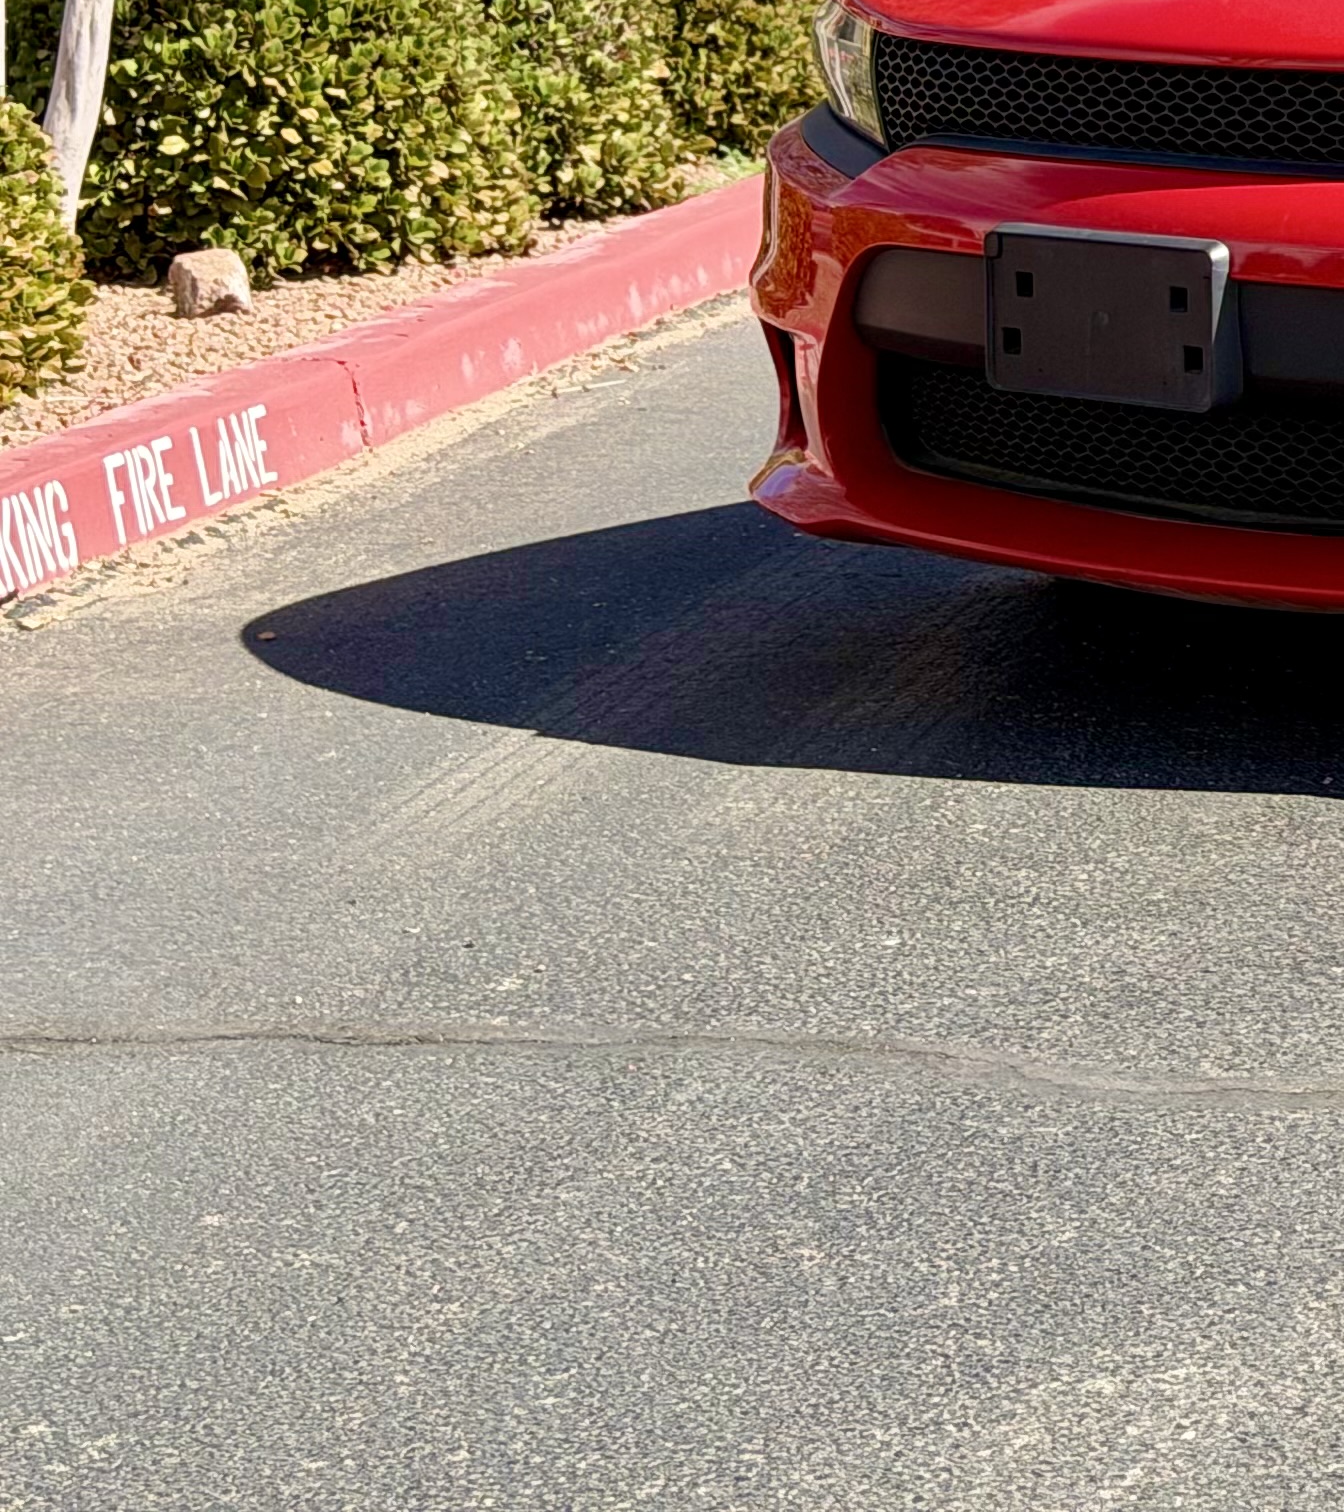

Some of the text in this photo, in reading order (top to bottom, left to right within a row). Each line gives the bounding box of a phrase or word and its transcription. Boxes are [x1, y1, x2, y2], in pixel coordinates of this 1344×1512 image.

[0, 403, 278, 598] KING FIRE LANE
